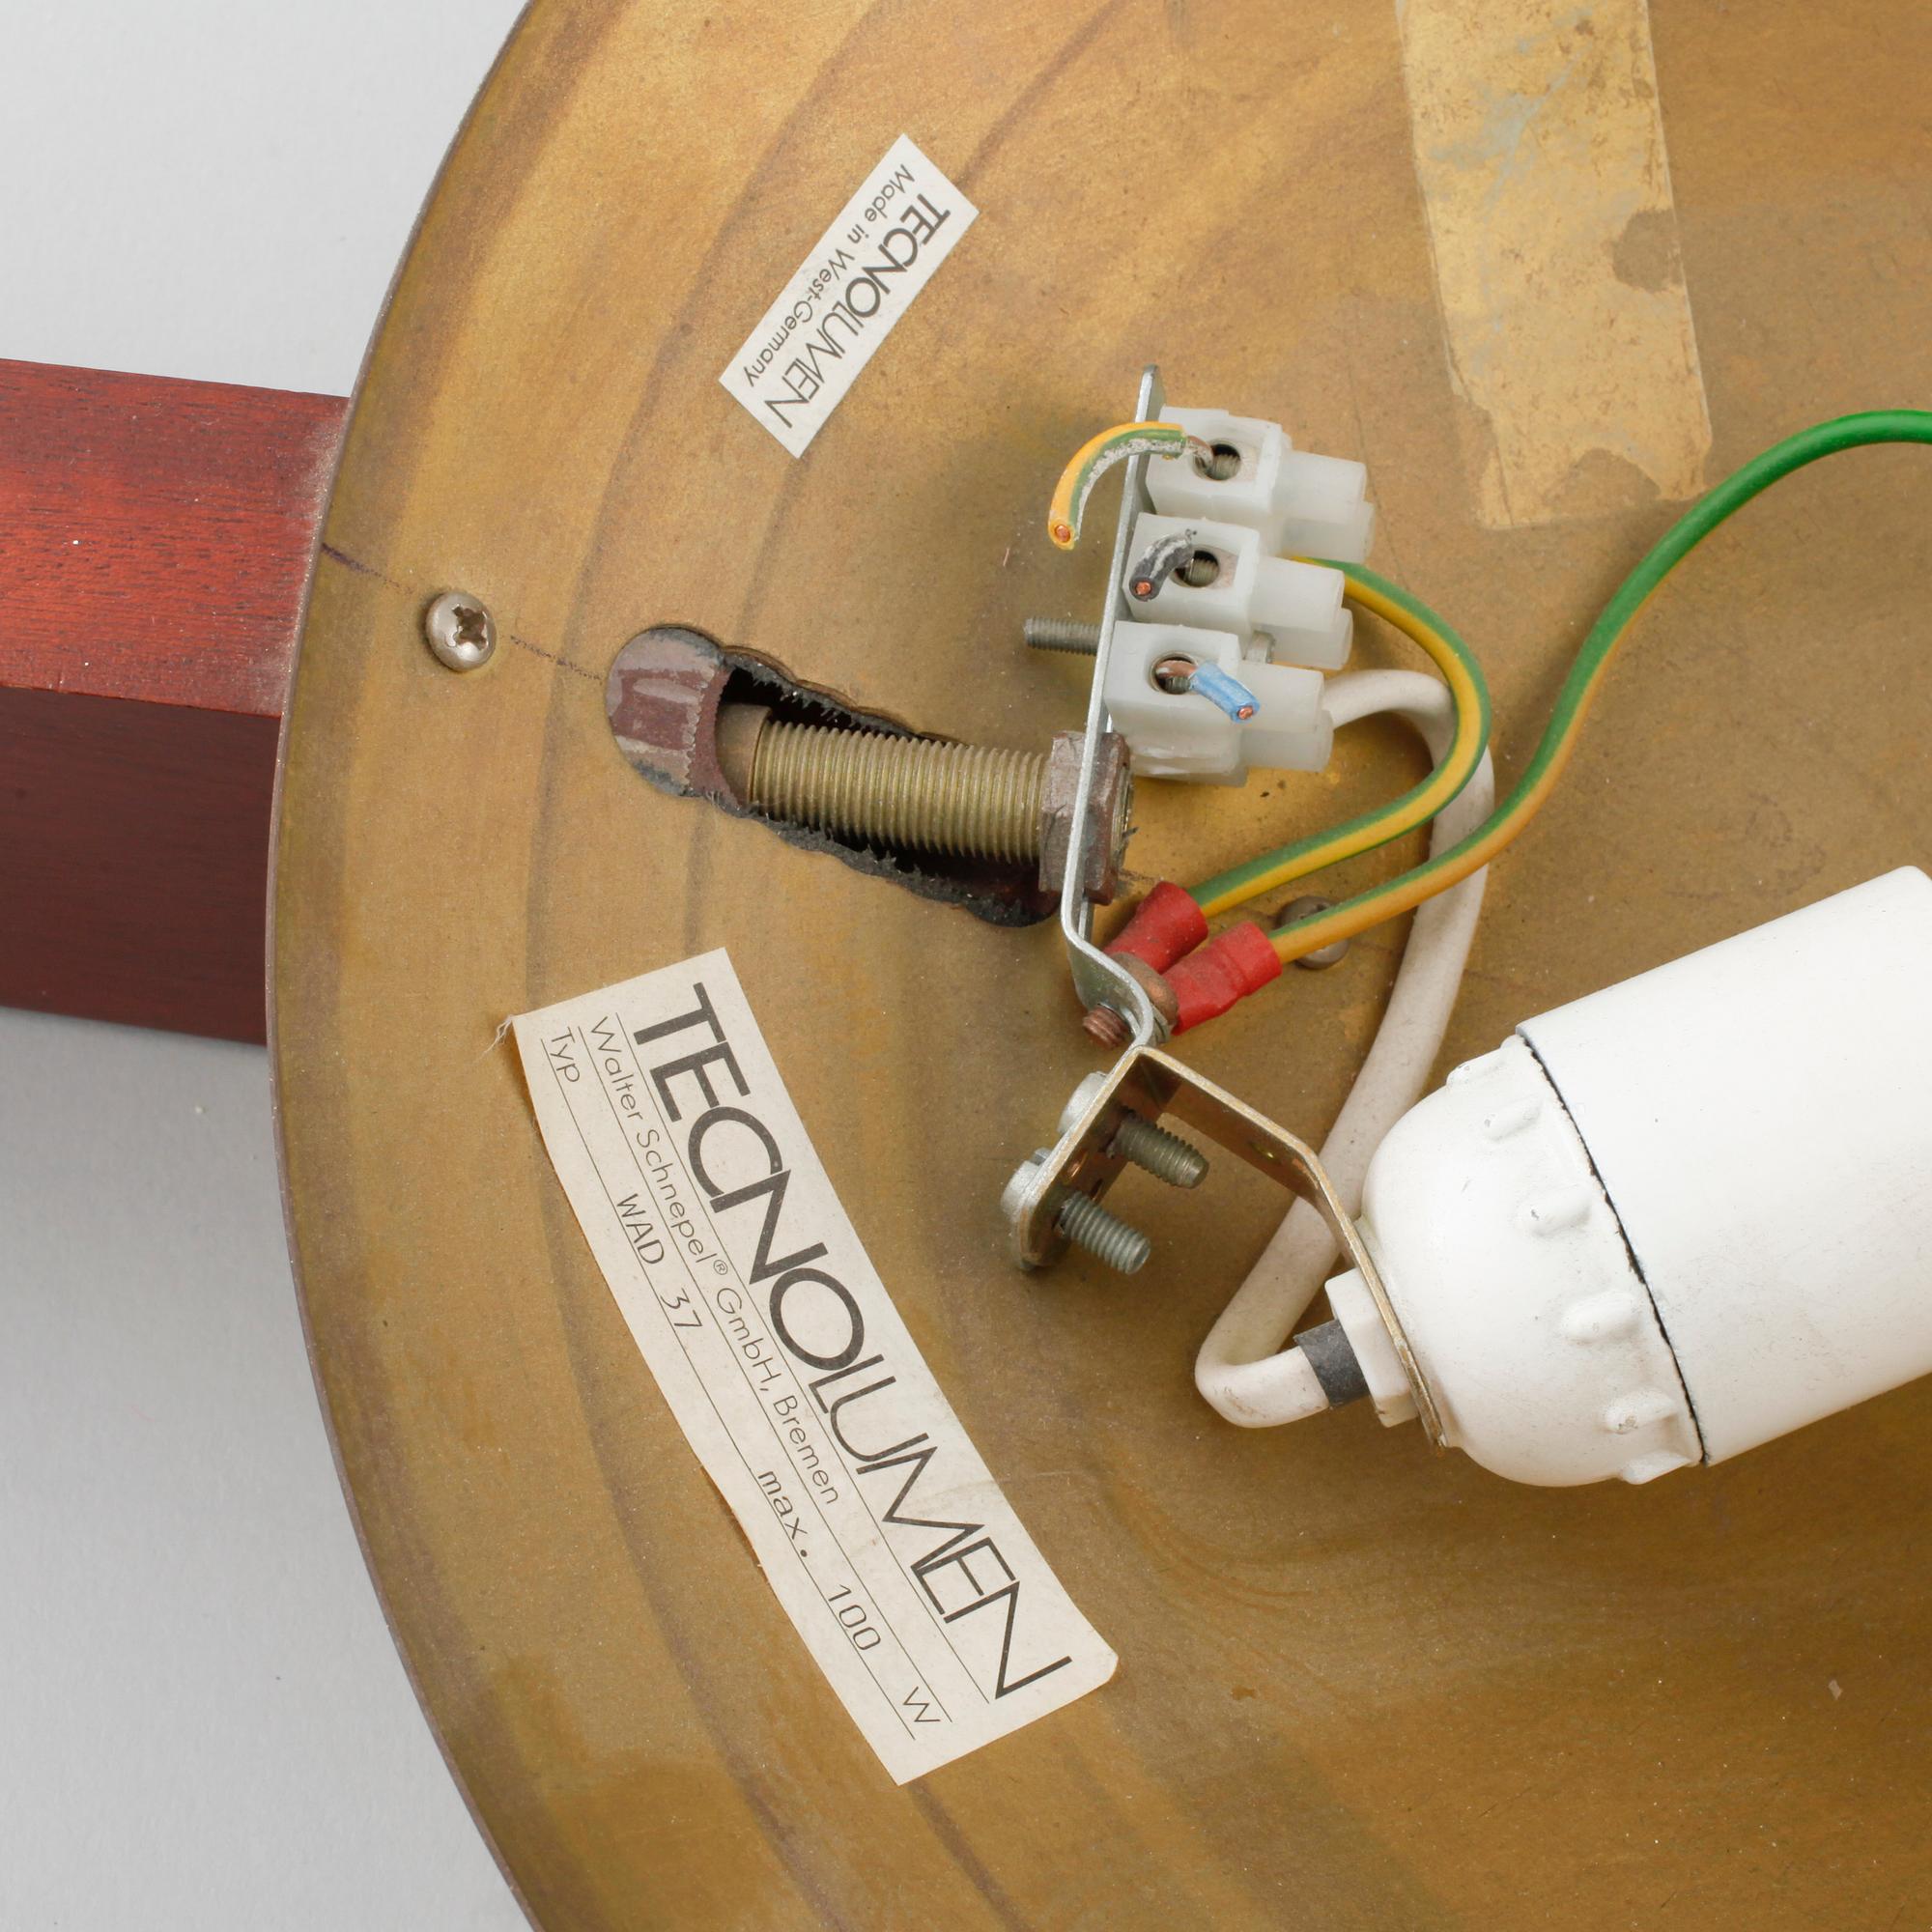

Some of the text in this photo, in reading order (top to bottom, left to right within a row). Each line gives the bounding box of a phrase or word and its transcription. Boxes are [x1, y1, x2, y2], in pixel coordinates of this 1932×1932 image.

[743, 164, 915, 387] Made in West-Germany
[764, 193, 951, 428] TECNOLUMEN
[549, 1026, 941, 1723] Typ WAD 37 max. 100 W
[590, 1015, 643, 1121] Walter
[716, 1287, 782, 1392] GmbH,
[773, 1394, 838, 1505] Bremen
[633, 981, 1072, 1699] TECNOLUMEN
